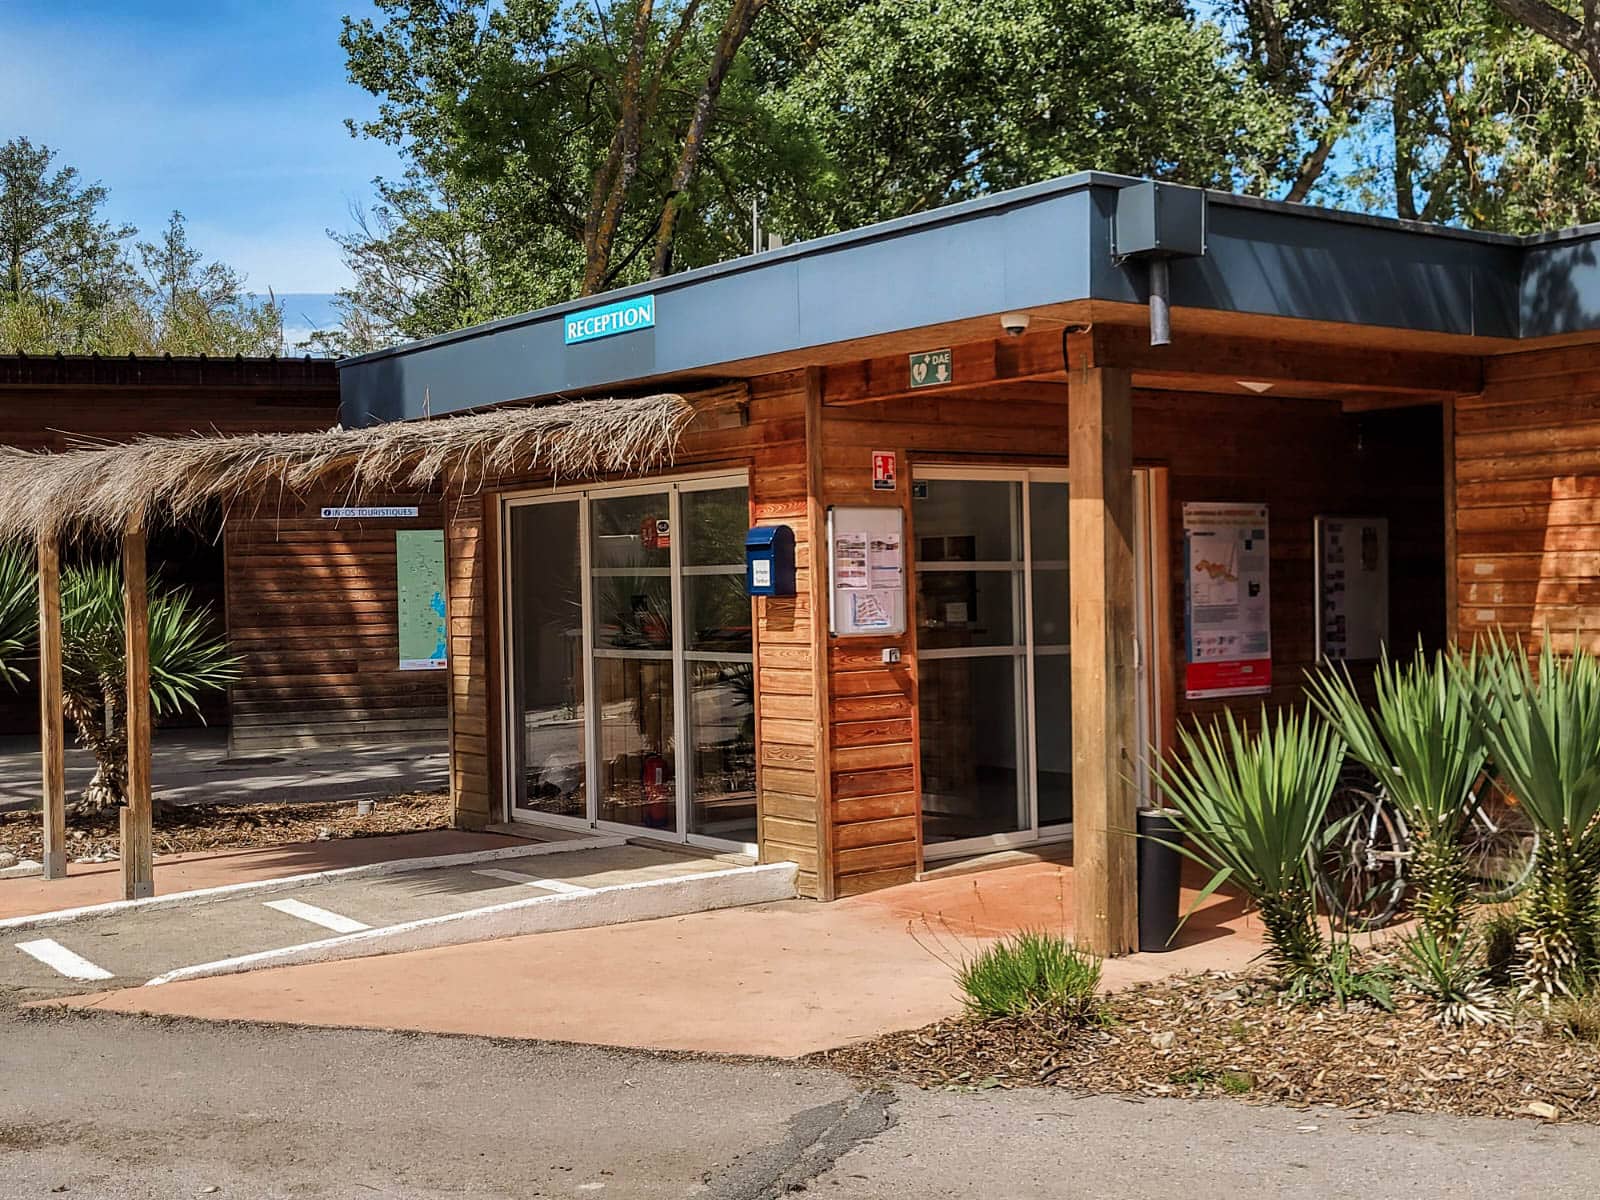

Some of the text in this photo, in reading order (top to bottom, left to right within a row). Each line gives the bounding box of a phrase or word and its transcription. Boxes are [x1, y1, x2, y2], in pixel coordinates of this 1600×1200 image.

[568, 304, 650, 339] RECEPTION
[932, 353, 950, 365] DAE
[358, 508, 413, 516] TOURISTIQUES
